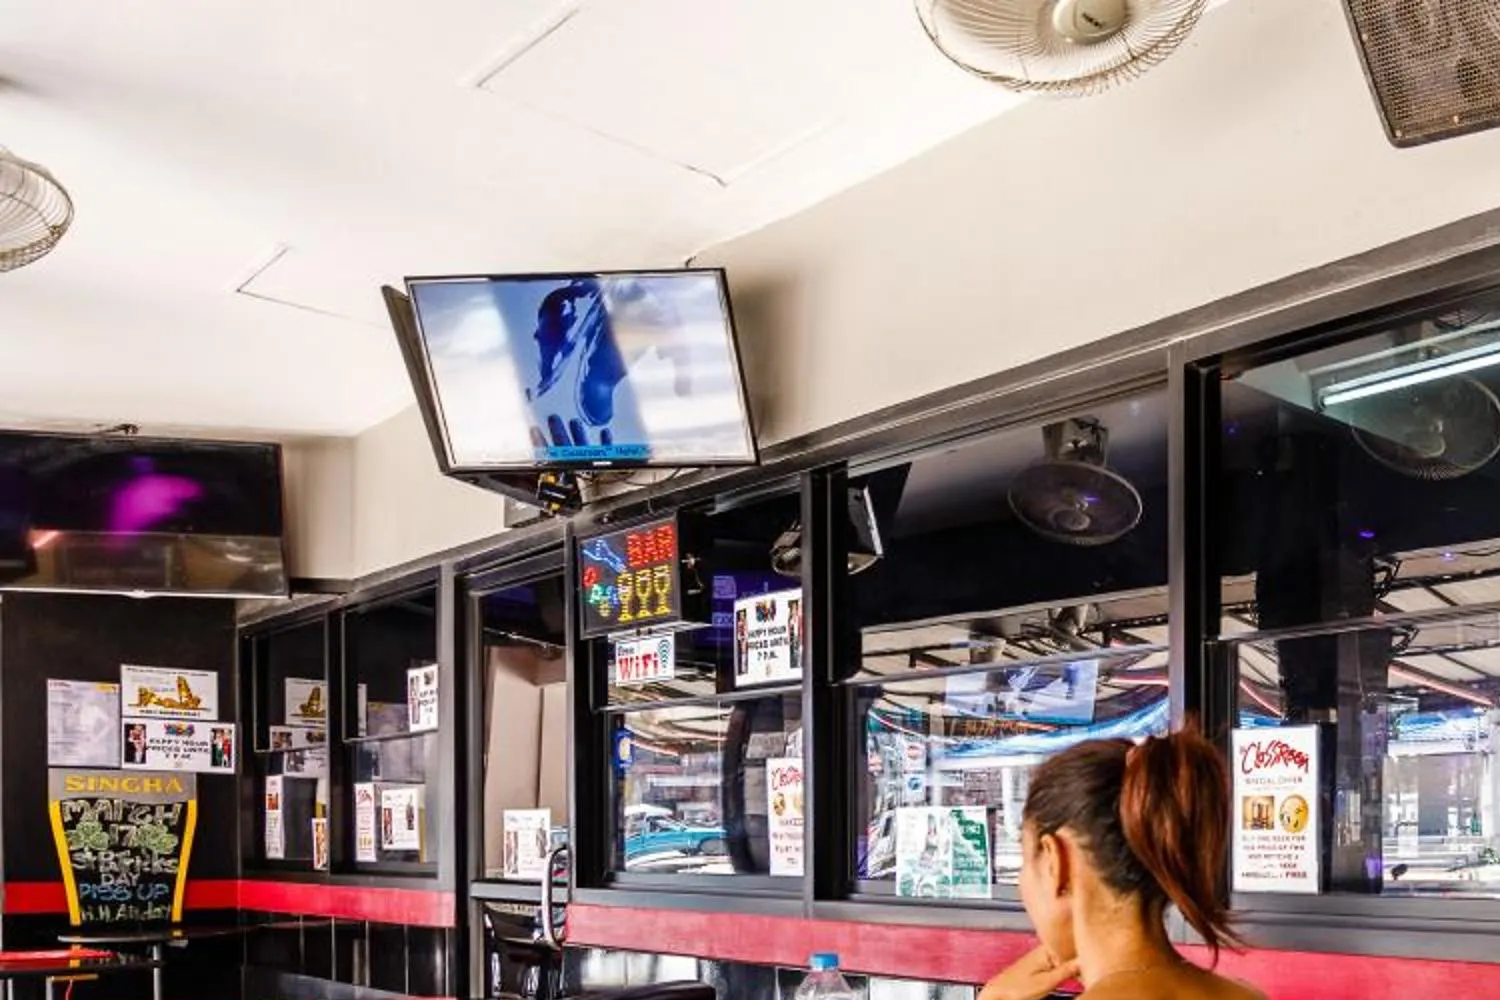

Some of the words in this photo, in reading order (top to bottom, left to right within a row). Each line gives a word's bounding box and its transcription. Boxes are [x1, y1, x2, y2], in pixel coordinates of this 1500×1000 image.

[64, 774, 184, 793] SINGHA
[100, 872, 141, 887] DAY
[136, 883, 169, 901] UP
